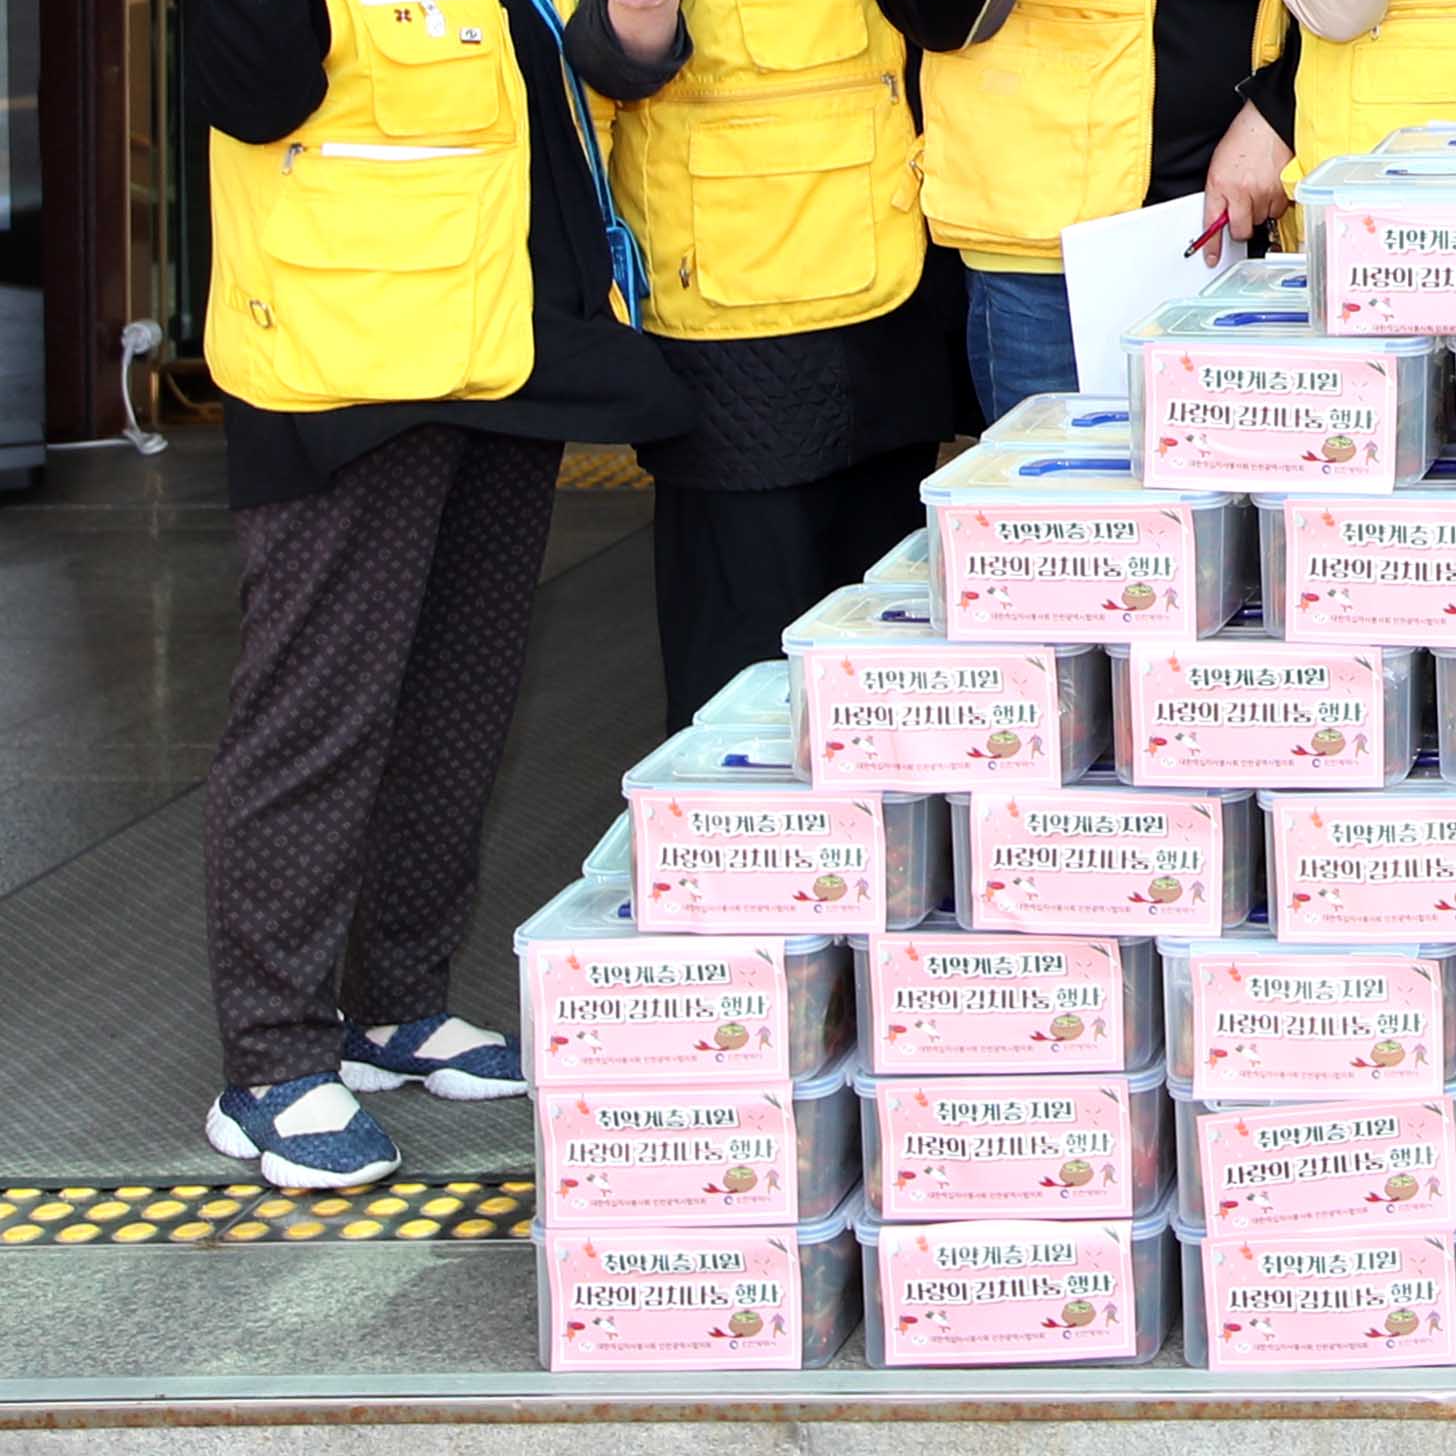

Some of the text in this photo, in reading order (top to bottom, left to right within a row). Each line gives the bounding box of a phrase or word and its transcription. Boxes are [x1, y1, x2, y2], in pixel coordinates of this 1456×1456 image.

[1350, 263, 1413, 287] 사랑의
[999, 521, 1135, 542] 취약계층 지원
[968, 553, 1172, 578] 사랑의 김치나눔 행사
[863, 670, 999, 690] 취약계층 지원
[833, 702, 1037, 726] 사랑의 김치나눔 행사
[690, 813, 826, 834] 취약계층 지원
[660, 845, 863, 869] 사랑의 김치나눔 행사
[589, 963, 727, 985] 취약계층 지원
[927, 955, 1063, 975] 취약계층 지원
[558, 994, 765, 1020] 사랑의 김치나눔 행사
[896, 986, 1101, 1009] 사랑의 김치나눔 행사
[605, 1252, 741, 1272] 취약계층 지원
[575, 1283, 779, 1306] 사랑의 김치나눔 행사
